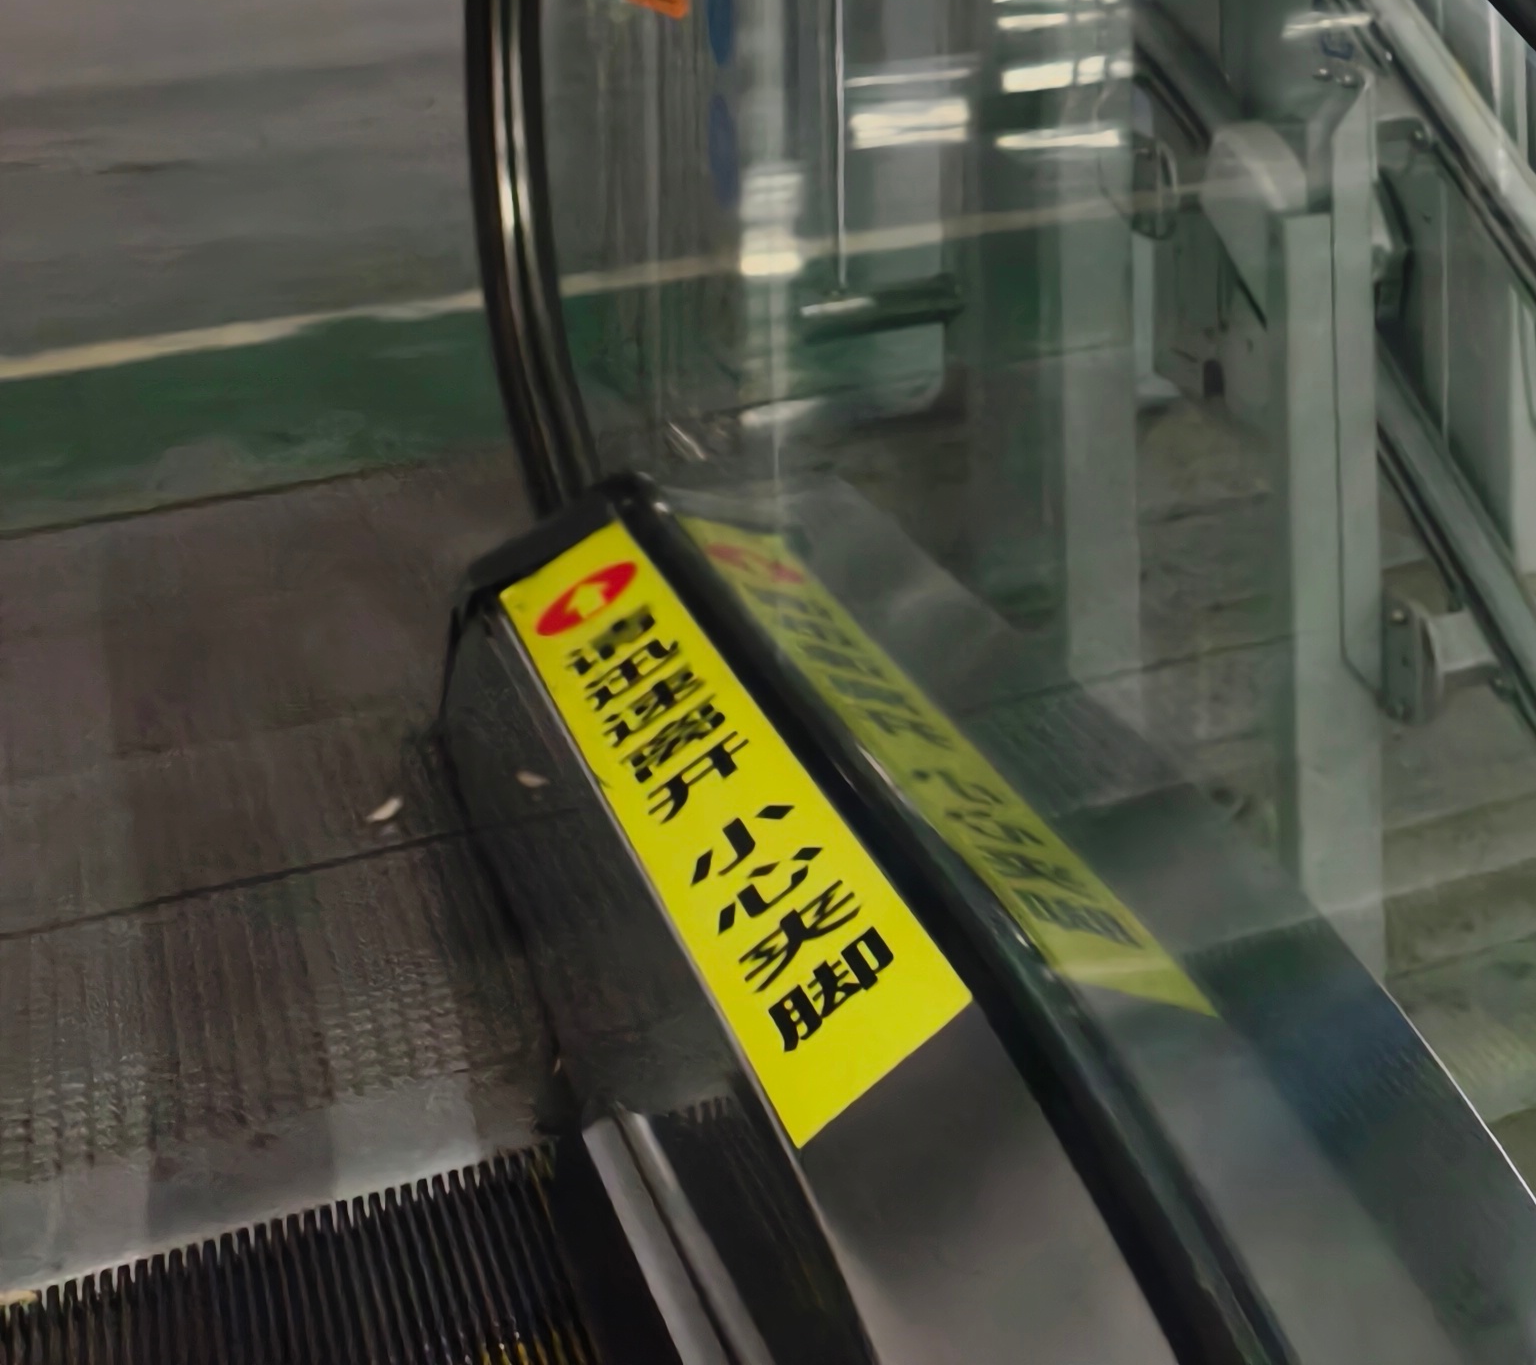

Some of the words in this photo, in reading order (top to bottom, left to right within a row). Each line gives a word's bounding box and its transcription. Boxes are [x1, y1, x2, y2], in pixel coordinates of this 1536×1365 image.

[566, 603, 749, 824] 请迅速离开
[690, 804, 894, 1053] 小心夹脚
